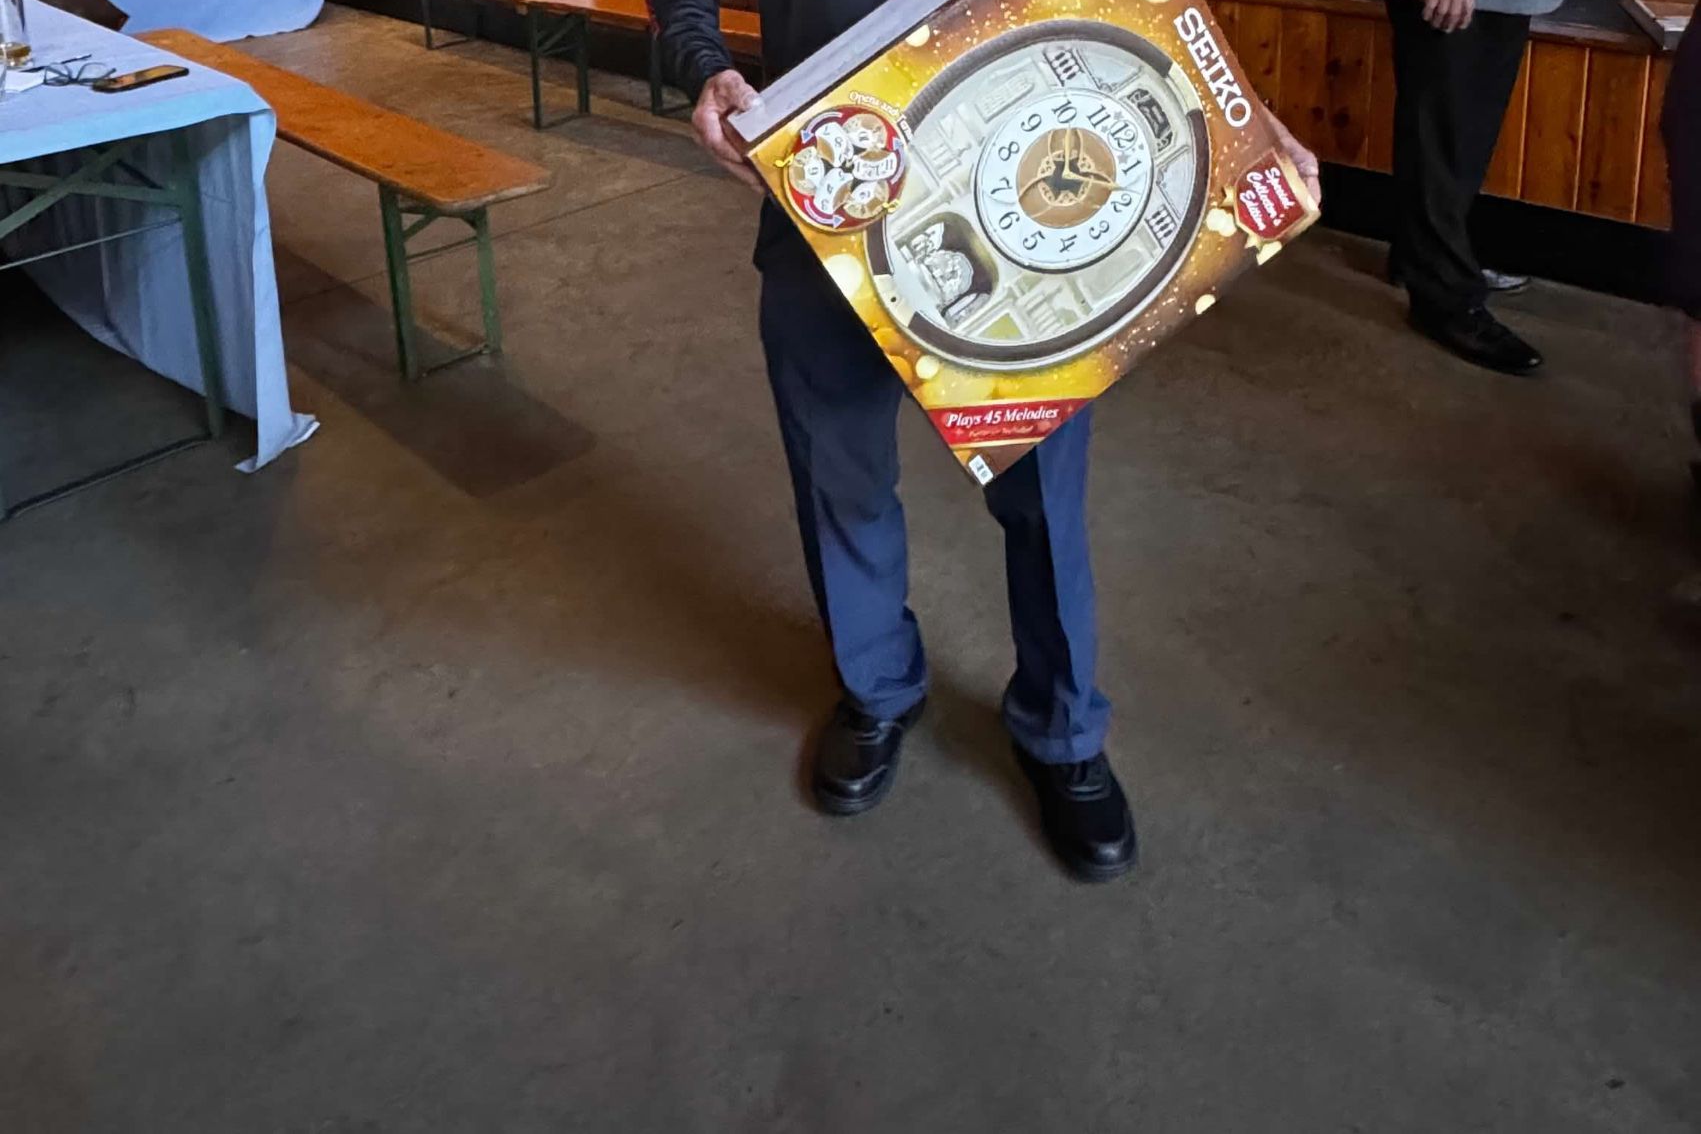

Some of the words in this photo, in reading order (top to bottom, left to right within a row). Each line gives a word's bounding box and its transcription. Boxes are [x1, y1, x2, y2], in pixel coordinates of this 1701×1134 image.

[1173, 7, 1252, 128] SEIKO
[1052, 99, 1077, 124] 10
[1087, 104, 1111, 128] 11
[1020, 113, 1042, 133] 9
[1110, 122, 1136, 149] 12
[998, 140, 1020, 162] 8
[990, 177, 1013, 196] 7
[1110, 193, 1132, 213] 2
[1239, 189, 1267, 231] Edition
[998, 211, 1021, 230] 6
[1088, 219, 1110, 240] 3
[1022, 230, 1046, 250] 5
[1059, 233, 1078, 253] 4
[947, 412, 982, 428] Plays
[983, 409, 1002, 425] 45
[1003, 405, 1060, 423] Melodies
